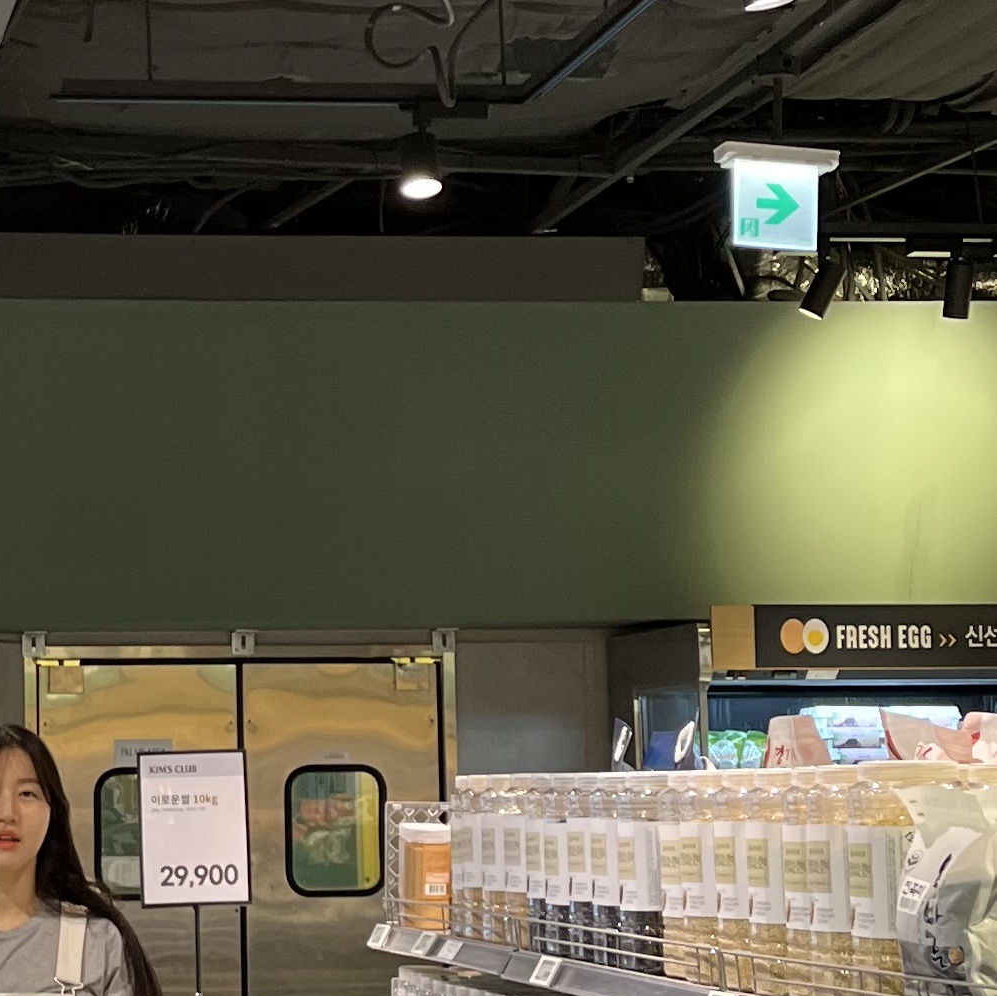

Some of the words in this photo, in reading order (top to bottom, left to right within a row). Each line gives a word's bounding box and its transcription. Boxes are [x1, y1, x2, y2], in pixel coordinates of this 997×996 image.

[835, 624, 893, 650] FRESH
[897, 624, 933, 649] EGG
[148, 765, 173, 775] KIM'S
[174, 764, 198, 774] CLUB
[193, 794, 219, 806] 10kg
[159, 863, 239, 889] 29,900
